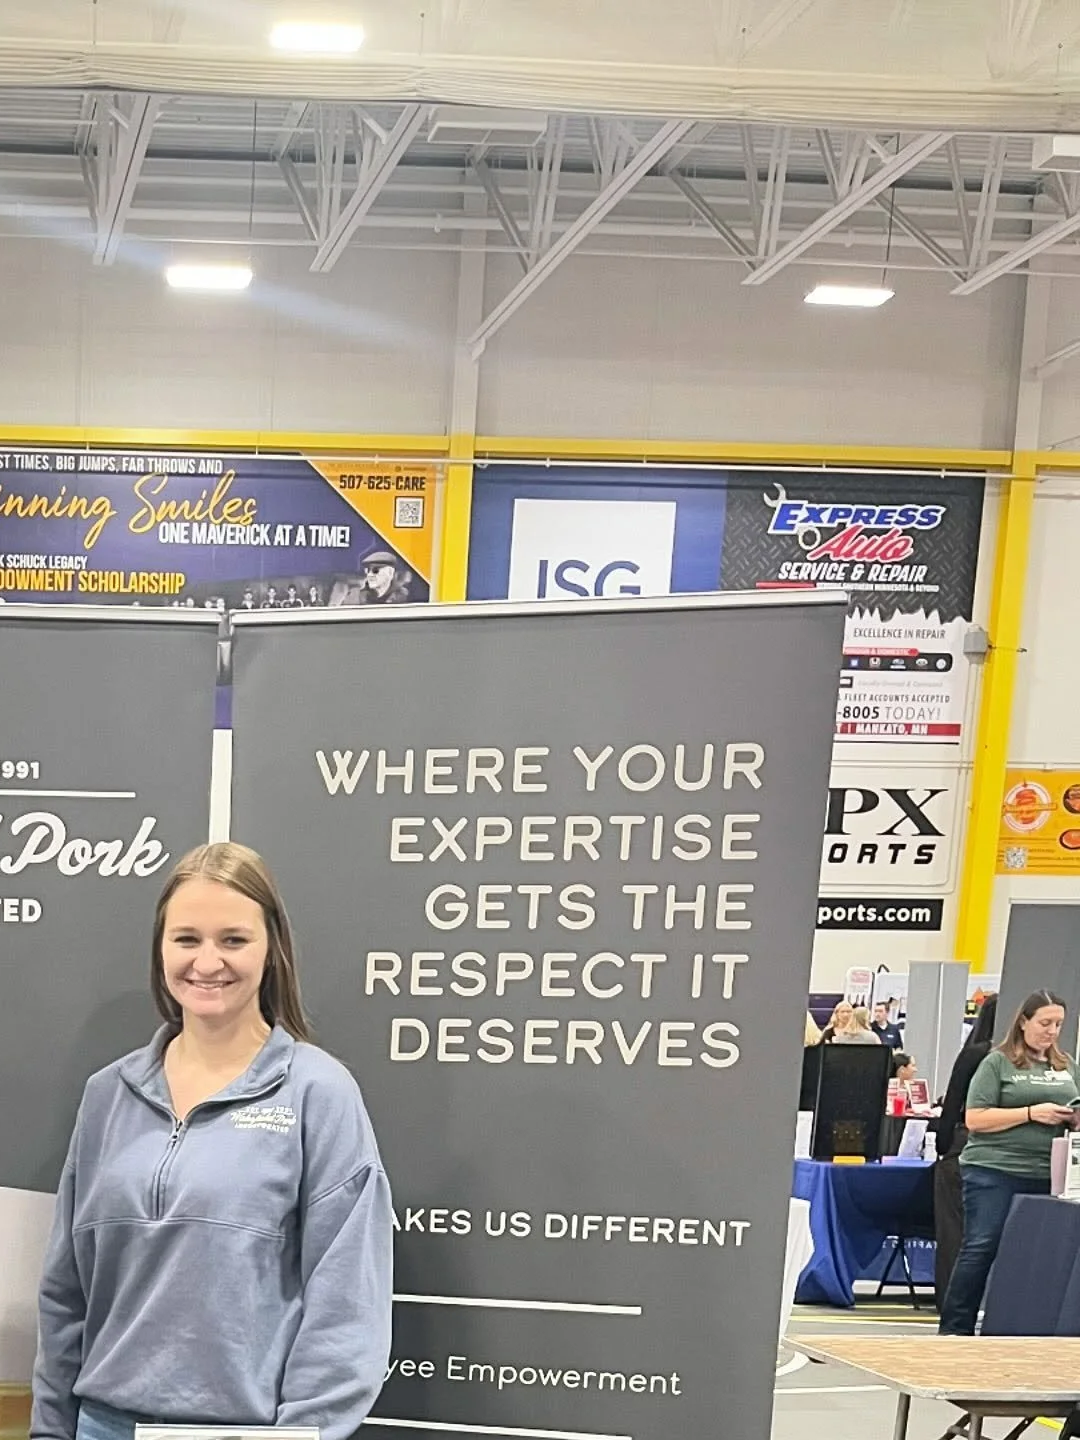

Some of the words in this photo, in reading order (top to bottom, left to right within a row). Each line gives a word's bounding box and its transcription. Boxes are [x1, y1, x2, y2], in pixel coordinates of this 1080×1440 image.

[14, 455, 52, 471] TIMES,
[56, 457, 76, 470] BIG
[78, 457, 119, 473] JUMPS,
[122, 458, 144, 472] FAR
[148, 459, 196, 473] THROWS
[198, 459, 222, 474] AND
[339, 475, 426, 491] 507-625-CARE
[128, 469, 257, 533] Smiles
[769, 501, 944, 533] EXPRESS
[159, 525, 190, 544] ONE
[192, 524, 270, 546] MAVERICK
[273, 526, 292, 546] AT
[295, 526, 306, 546] A
[308, 526, 349, 547] TIME!
[807, 525, 913, 561] Auto
[7, 554, 47, 569] SCHUCK
[49, 556, 88, 570] LEGACY
[779, 562, 850, 581] SERVICE
[851, 563, 864, 580] &
[868, 565, 928, 582] REPAIR
[78, 571, 185, 594] SCHOLARSHIP
[537, 560, 641, 599] ISG
[854, 628, 903, 638] EXCELLENCE
[904, 629, 913, 638] IN
[915, 629, 946, 639] REPAIR
[844, 693, 867, 701] FLEET
[870, 694, 909, 702] ACCOUNTS
[912, 695, 950, 703] ACCEPTED
[884, 707, 940, 720] TODAY!
[315, 747, 550, 795] WHERE
[572, 743, 766, 792] YOUR
[0, 811, 170, 877] Pork
[389, 814, 761, 862] EXPERTISE
[424, 883, 596, 930] GETS
[622, 883, 755, 930] THE
[817, 904, 932, 924] ports.com
[364, 951, 667, 999] RESPECT
[691, 953, 749, 999] IT
[389, 1017, 741, 1068] DESERVES
[485, 1211, 532, 1237] US
[544, 1213, 752, 1247] DIFFERENT
[446, 1355, 683, 1396] Empowerment
